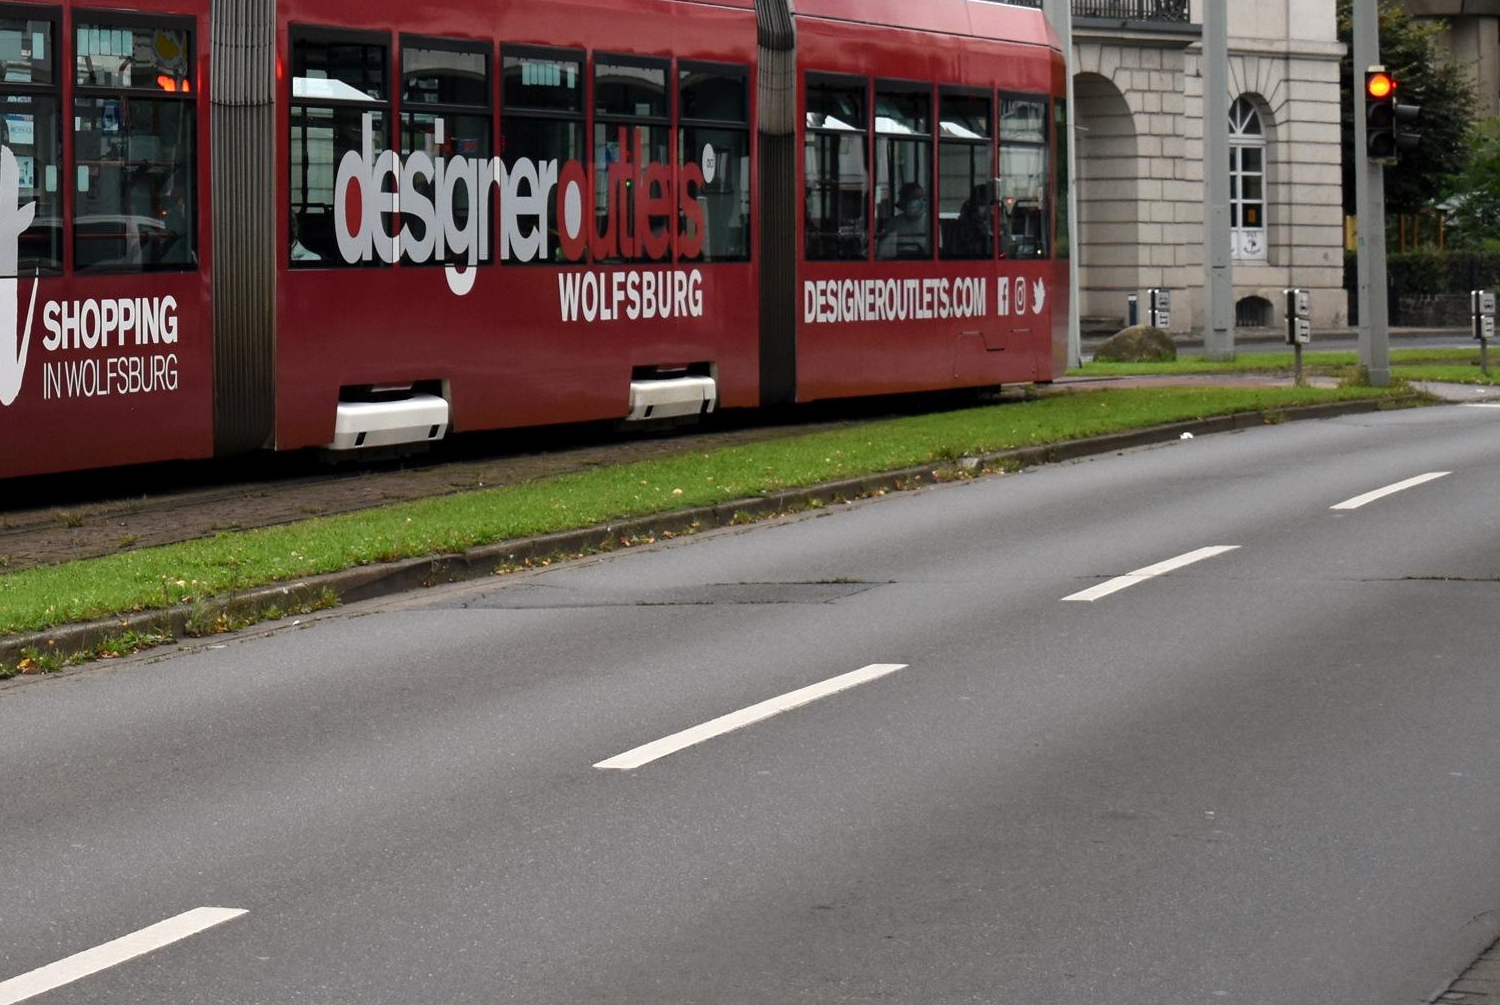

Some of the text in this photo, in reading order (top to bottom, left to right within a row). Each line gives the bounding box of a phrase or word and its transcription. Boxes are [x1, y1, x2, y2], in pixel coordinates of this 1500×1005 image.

[559, 269, 703, 322] WOLFSBURG
[804, 277, 986, 323] DESIGNEROUTLETS.COM
[42, 295, 177, 351] SHOPPING
[43, 353, 177, 399] IN WOLFSBURG
